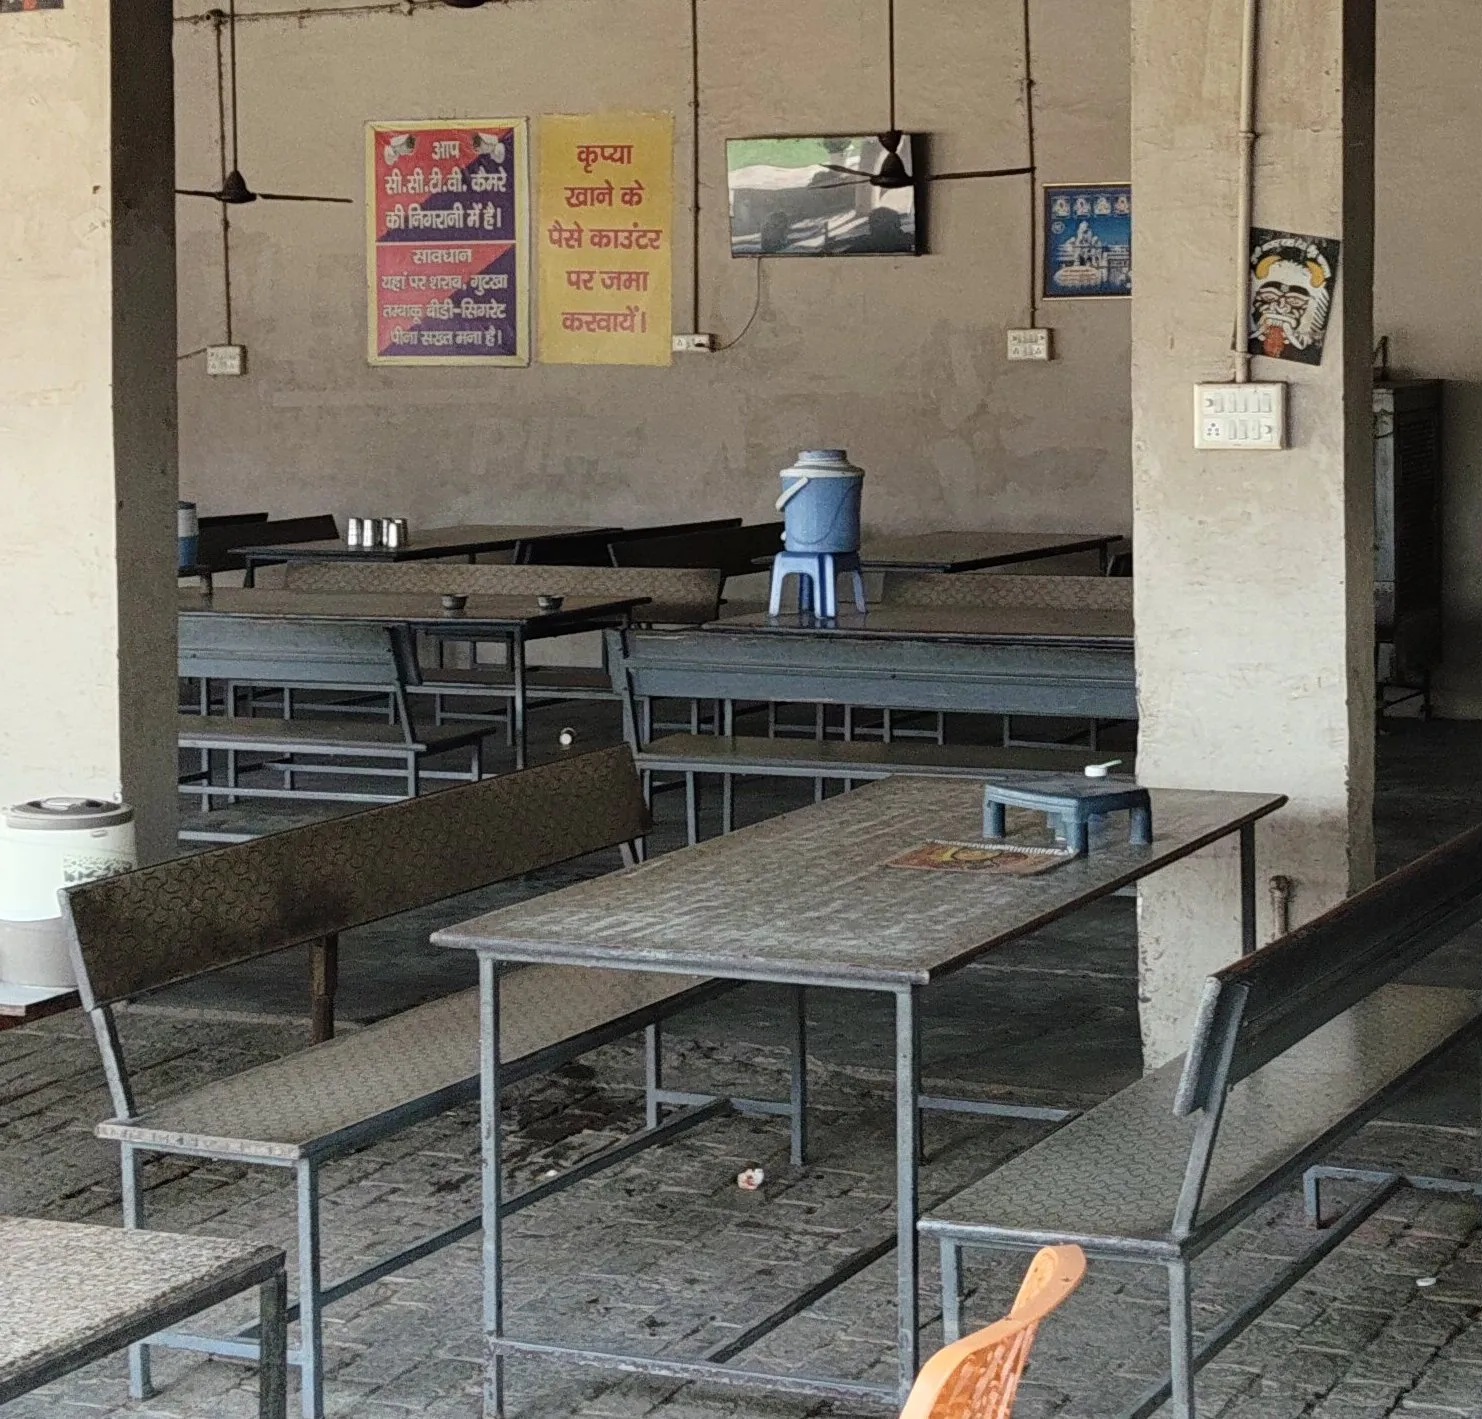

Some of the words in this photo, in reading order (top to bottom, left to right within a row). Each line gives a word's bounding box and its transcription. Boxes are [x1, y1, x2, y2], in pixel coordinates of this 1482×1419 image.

[432, 140, 460, 160] आप
[576, 144, 634, 173] कृप्या
[384, 166, 467, 194] सी.सी.टी.वी.
[564, 179, 614, 208] खाने
[620, 179, 644, 207] के
[385, 203, 405, 229] की
[407, 202, 464, 229] निगरानी
[466, 202, 482, 228] में
[548, 220, 584, 249] पैसे
[589, 222, 663, 250] काउंटर
[412, 249, 472, 264] सावधान
[381, 271, 405, 291] यहां
[409, 275, 427, 290] पर
[470, 274, 508, 295] गुटखा
[566, 270, 596, 291] पर
[600, 271, 649, 291] जमा
[562, 305, 647, 333] करवायें।
[390, 325, 418, 345] पीना
[420, 330, 453, 345] सख्त
[455, 330, 482, 345] मना
